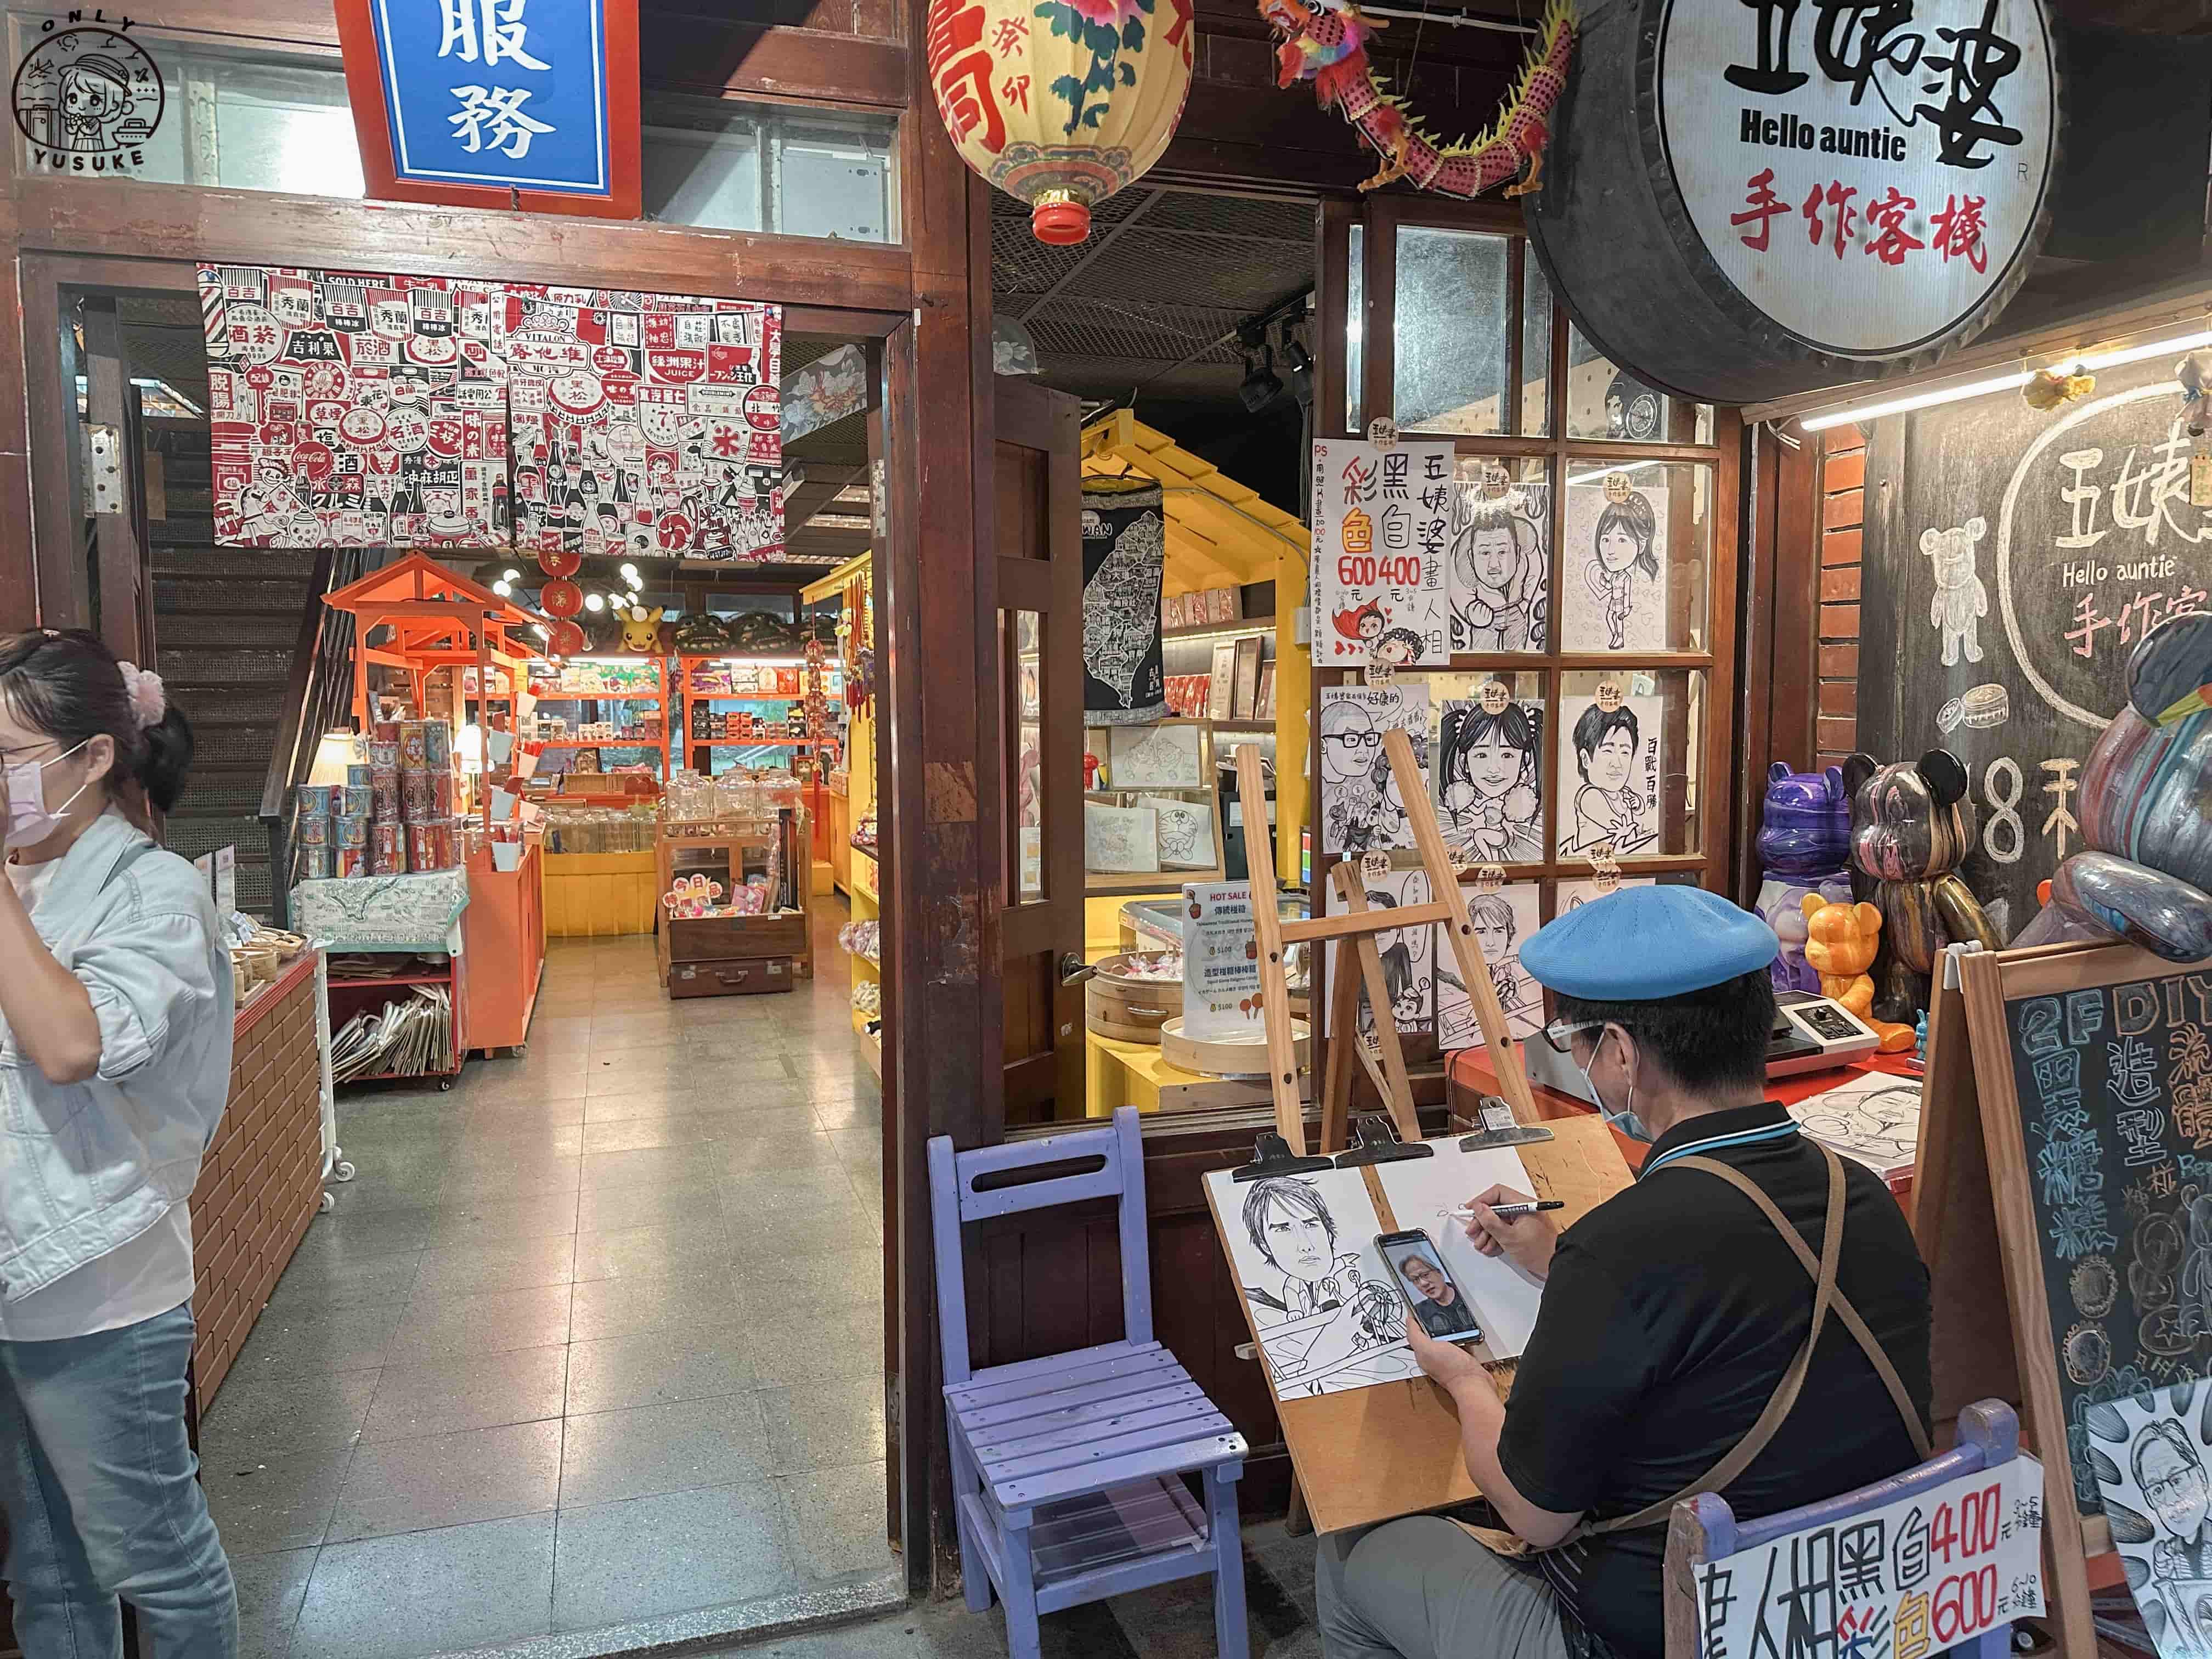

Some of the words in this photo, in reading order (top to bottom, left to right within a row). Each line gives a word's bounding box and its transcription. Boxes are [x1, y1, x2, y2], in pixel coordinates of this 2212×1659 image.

[992, 16, 1030, 115] 癸卯
[1740, 109, 1814, 151] Hello
[1820, 125, 1906, 161] auntie
[1731, 168, 1988, 274] 手作客棧
[292, 340, 335, 356] 吉利果
[525, 333, 566, 343] VITALON
[664, 369, 695, 377] JUICE
[1314, 445, 1328, 457] PS
[2055, 417, 2212, 549] 五姨
[1342, 456, 1379, 554] 彩色
[1381, 453, 1412, 549] 黑白
[1338, 555, 1376, 586] 600
[1379, 555, 1421, 586] 400
[2063, 560, 2108, 588] Hello
[2117, 554, 2175, 581] auntie
[1351, 589, 1363, 601] 元
[1390, 588, 1404, 602] 元
[1645, 737, 1657, 810] 百戰百勝
[1210, 893, 1227, 901] HOT
[1228, 891, 1247, 900] SALE
